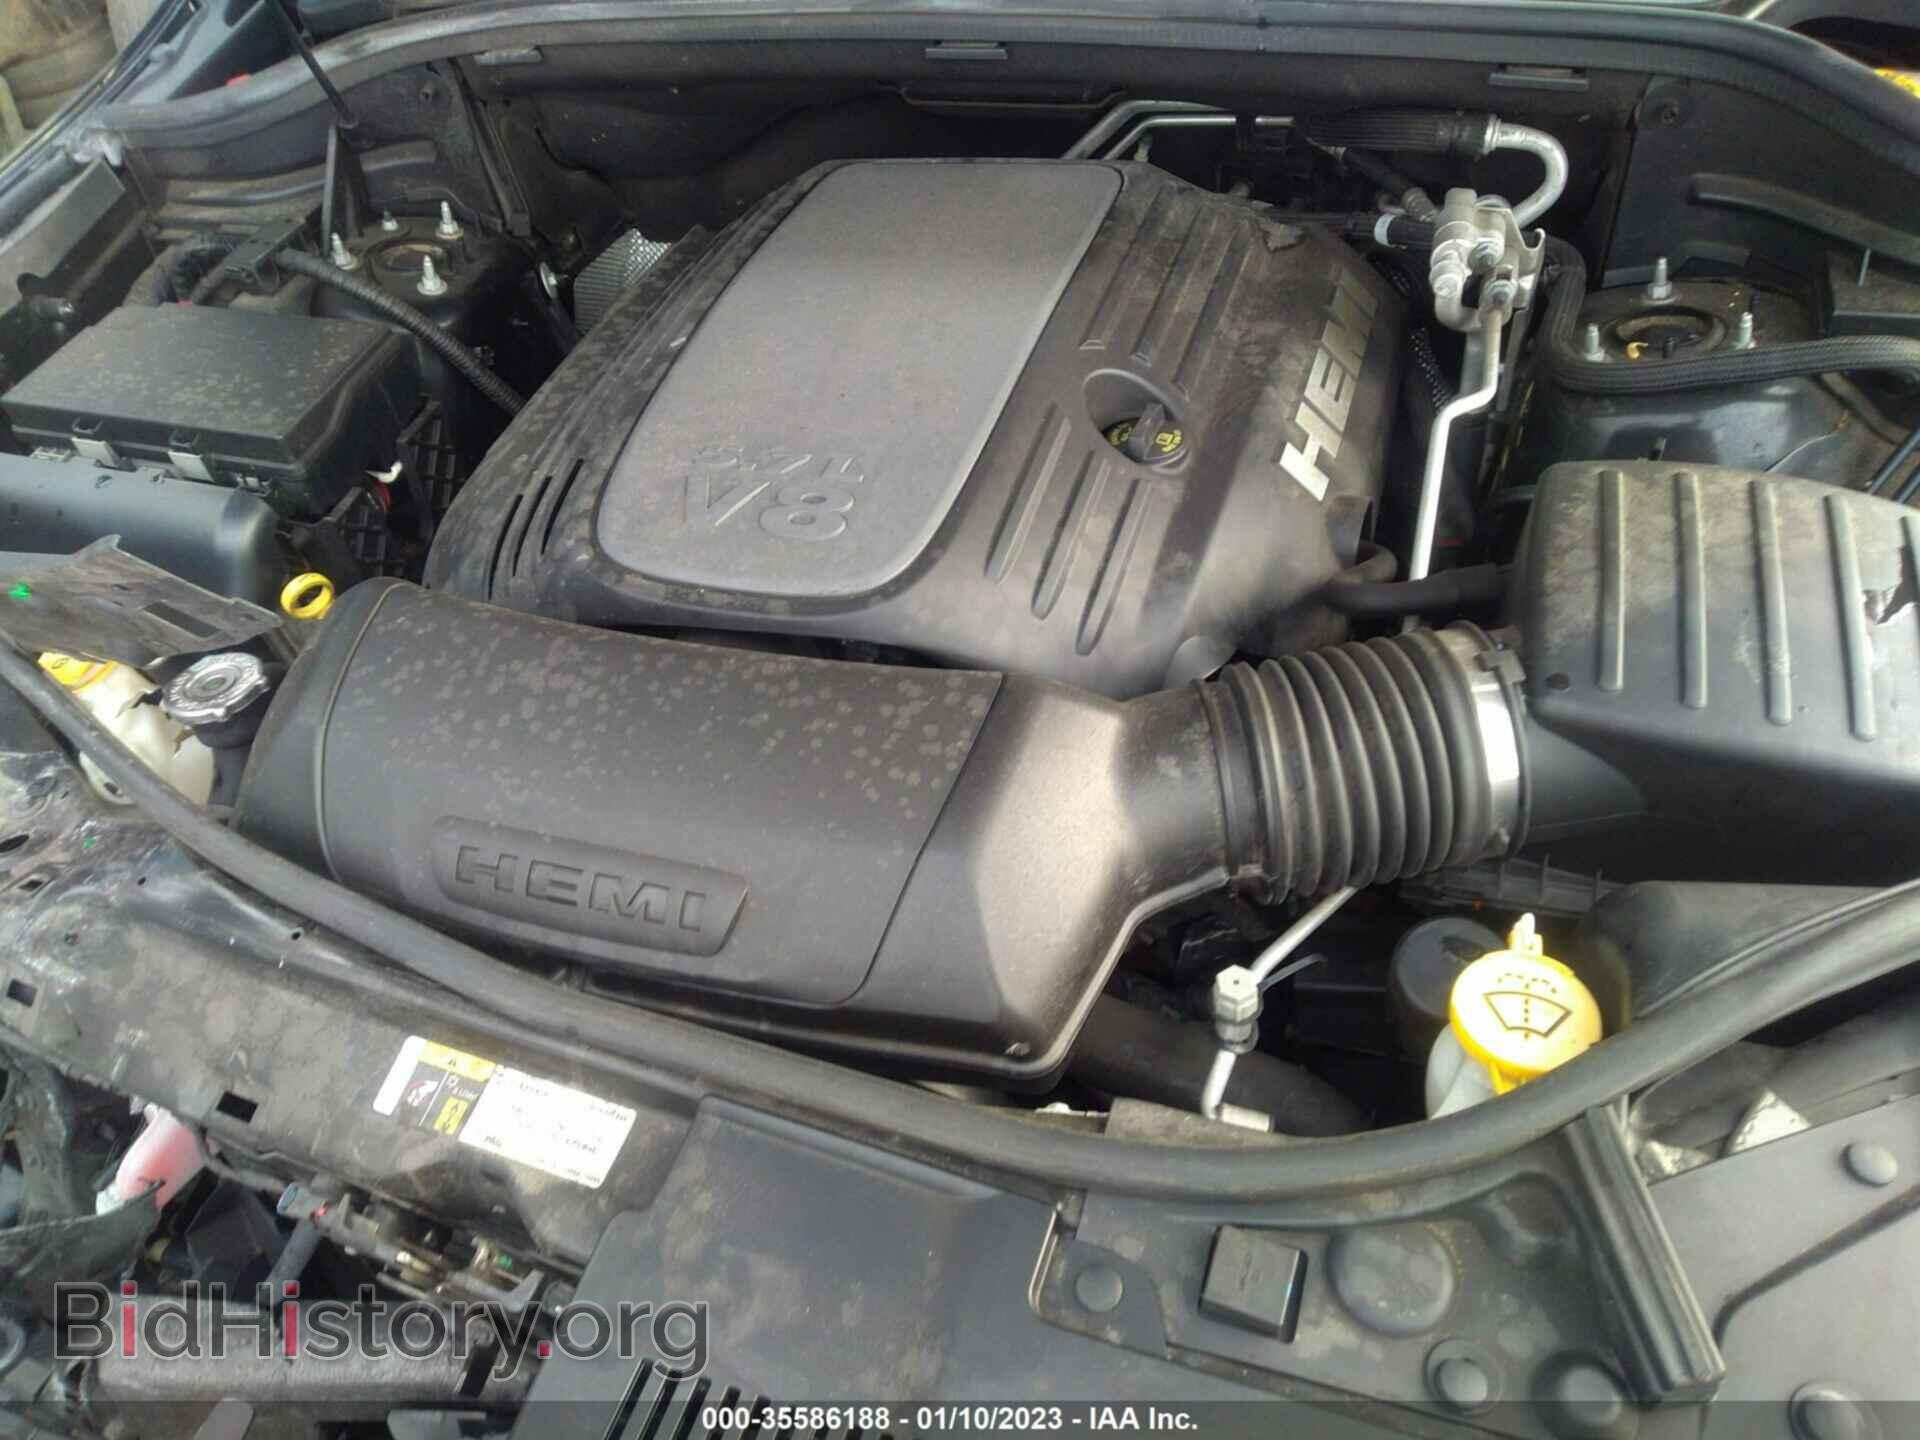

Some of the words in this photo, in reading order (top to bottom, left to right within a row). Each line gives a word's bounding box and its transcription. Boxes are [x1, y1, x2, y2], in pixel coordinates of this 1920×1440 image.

[1279, 263, 1378, 502] HEMI
[682, 470, 857, 543] V8
[455, 844, 707, 933] HEMI
